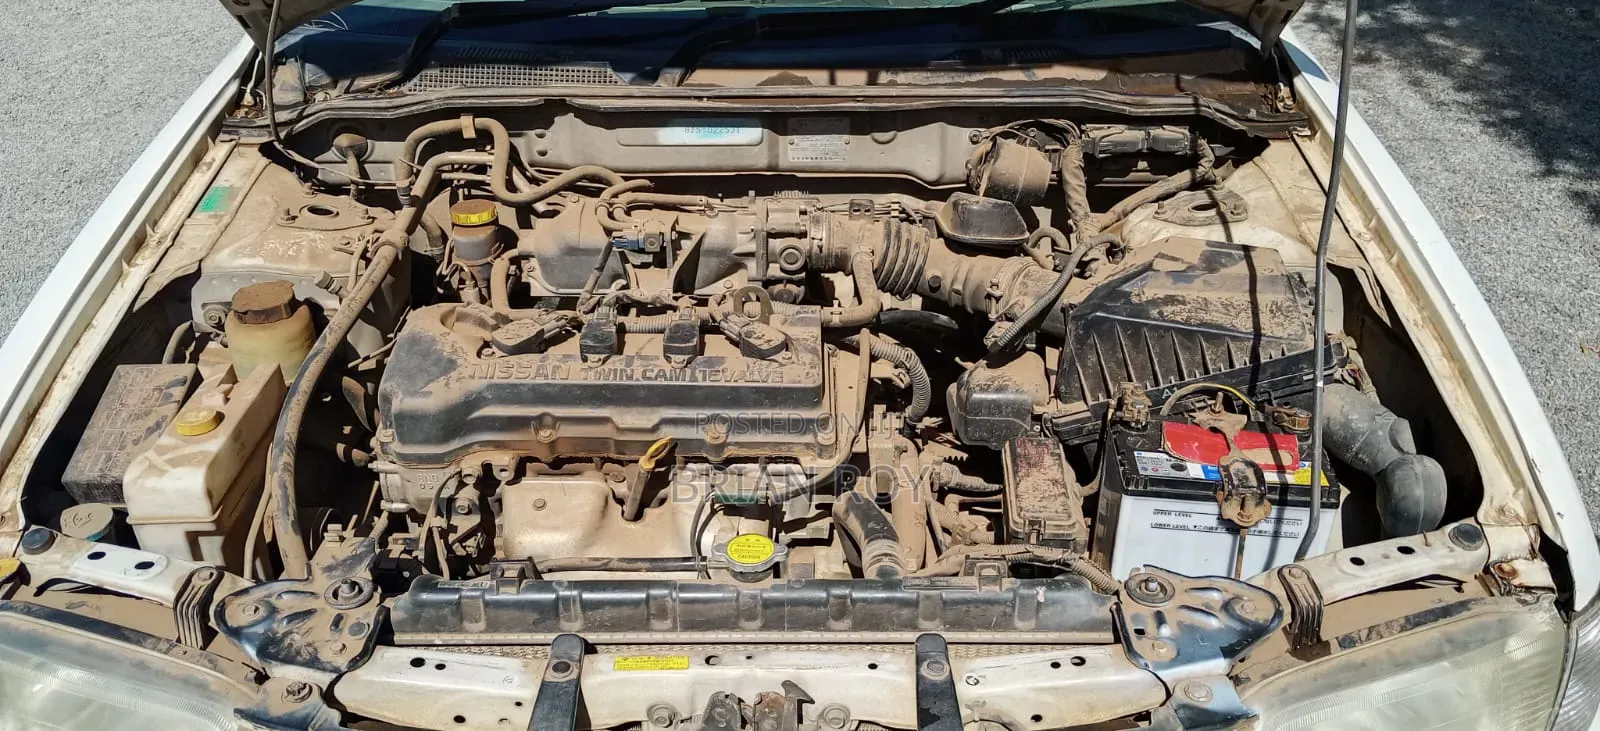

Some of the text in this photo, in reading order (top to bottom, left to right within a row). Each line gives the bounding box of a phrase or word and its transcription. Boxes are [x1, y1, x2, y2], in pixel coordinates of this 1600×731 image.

[470, 363, 571, 380] NISSAN
[580, 366, 635, 381] TWIN
[641, 368, 687, 382] CAM
